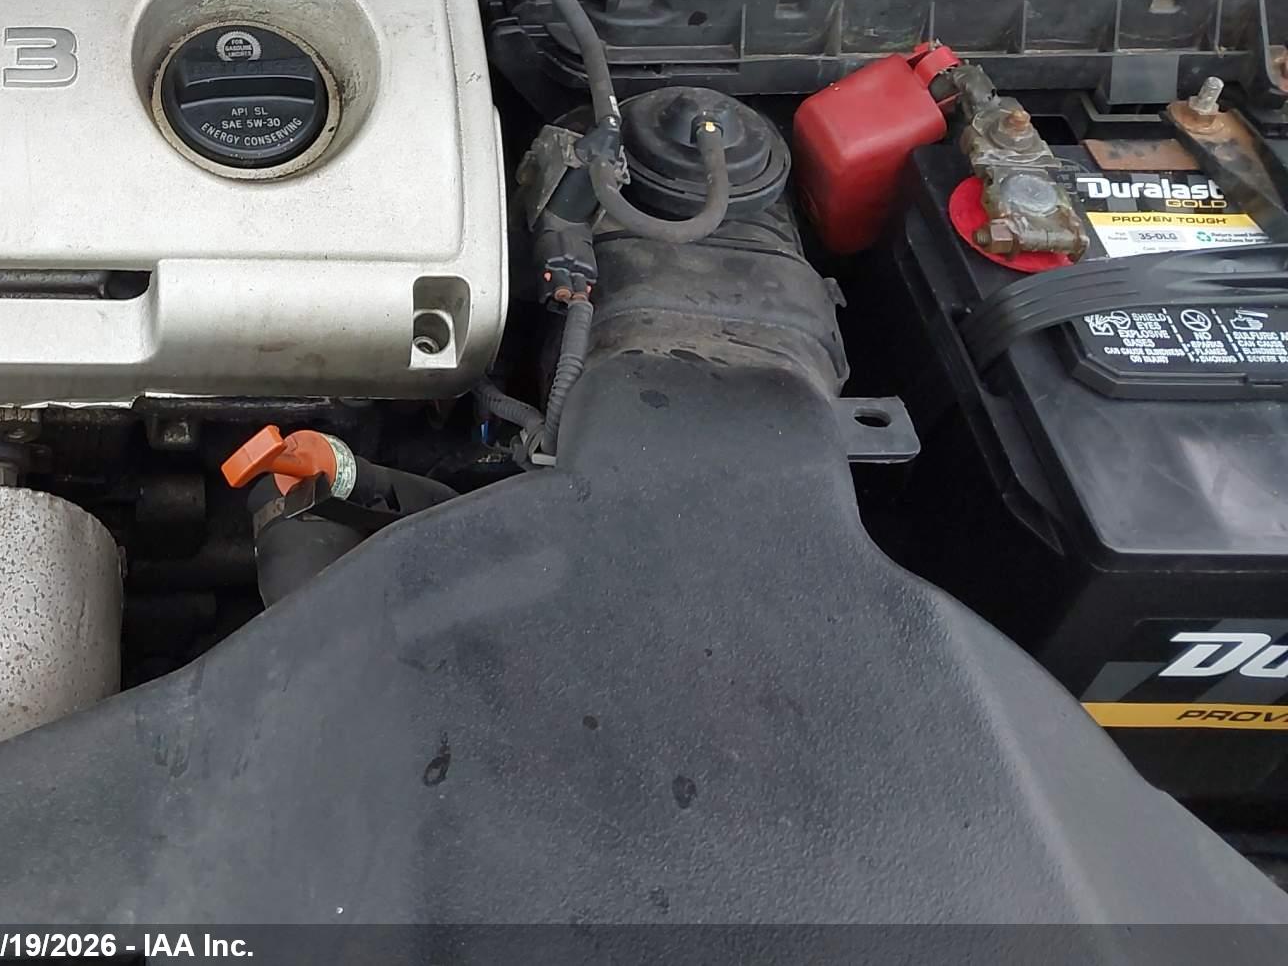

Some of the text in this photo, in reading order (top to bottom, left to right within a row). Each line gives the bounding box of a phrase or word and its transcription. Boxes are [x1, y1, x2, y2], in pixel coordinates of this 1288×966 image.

[232, 106, 268, 116] API SL
[221, 117, 281, 129] SAE 5W-30
[200, 117, 303, 146] ENERGY CONSERVING
[1076, 177, 1225, 199] Duralast
[1165, 199, 1228, 209] GOLD
[1112, 215, 1227, 225] PROVEN TOUGH
[1132, 313, 1166, 321] SHIELD
[1136, 321, 1161, 330] EYES
[1118, 329, 1170, 338] EXPLOSIVE
[1193, 331, 1212, 340] NO
[1233, 331, 1279, 340] SULFURIC
[1122, 338, 1155, 347] GASES
